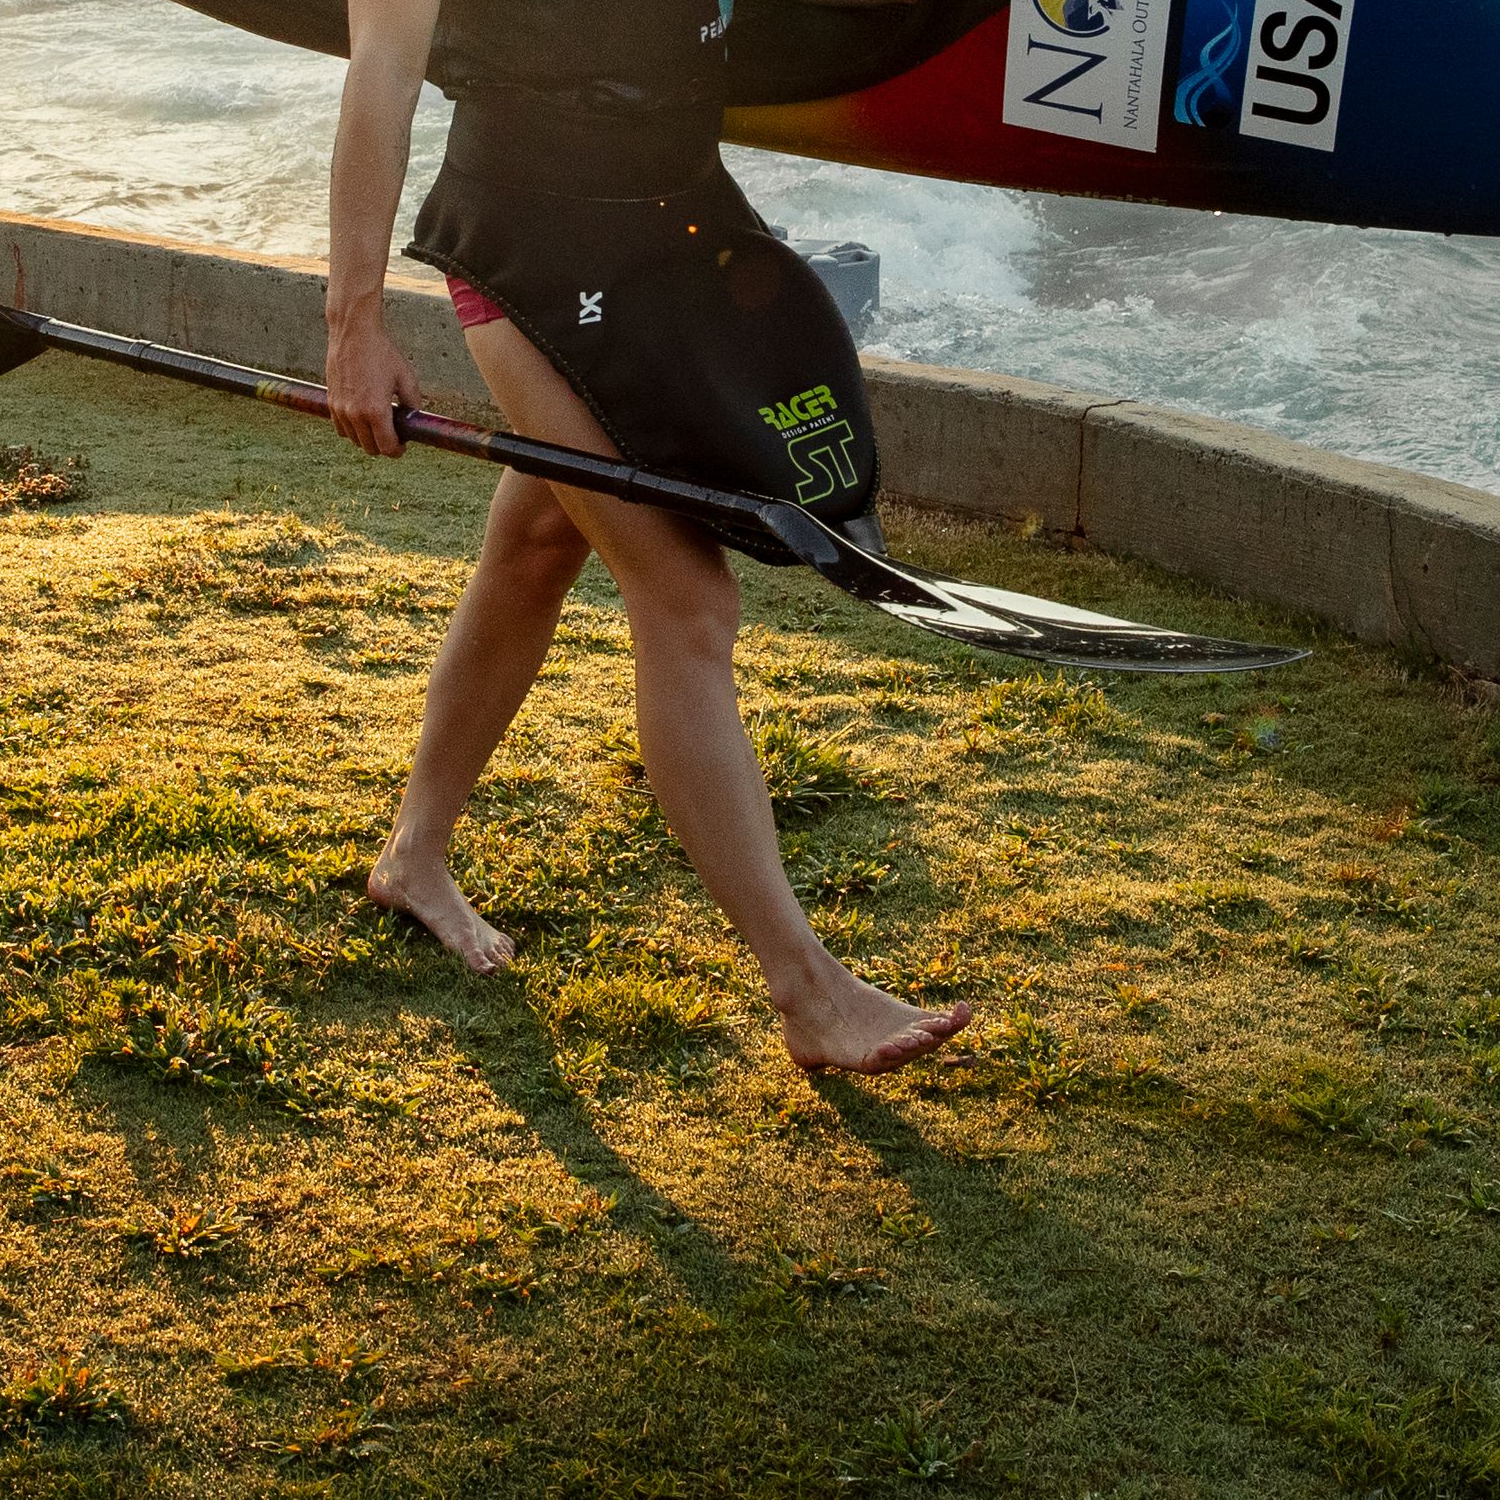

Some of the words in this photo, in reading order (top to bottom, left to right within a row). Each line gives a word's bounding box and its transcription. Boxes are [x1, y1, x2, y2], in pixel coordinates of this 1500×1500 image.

[1123, 38, 1148, 131] NANTAHALA
[757, 384, 838, 431] RACER
[781, 425, 808, 439] DESIGN
[809, 414, 835, 429] PATENT
[788, 420, 859, 505] ST
